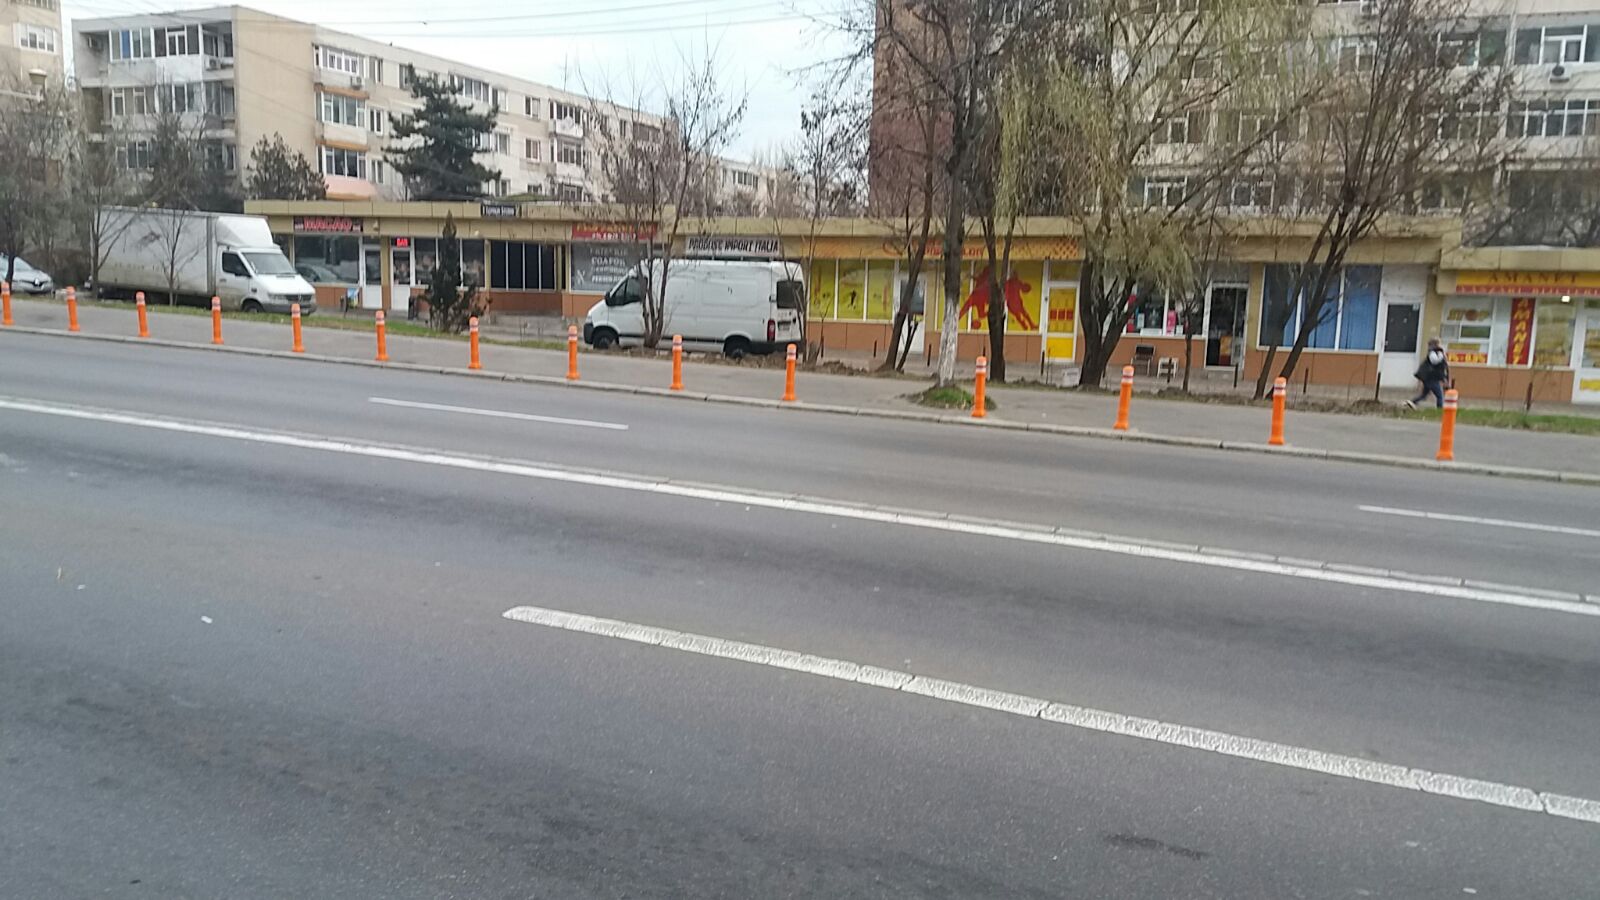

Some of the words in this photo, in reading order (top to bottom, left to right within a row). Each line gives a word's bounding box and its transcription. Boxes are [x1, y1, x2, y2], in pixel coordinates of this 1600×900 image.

[724, 239, 753, 252] IMPORT
[755, 239, 779, 253] ITALIA
[1489, 272, 1577, 283] AMANET
[1513, 299, 1531, 364] AMANET
